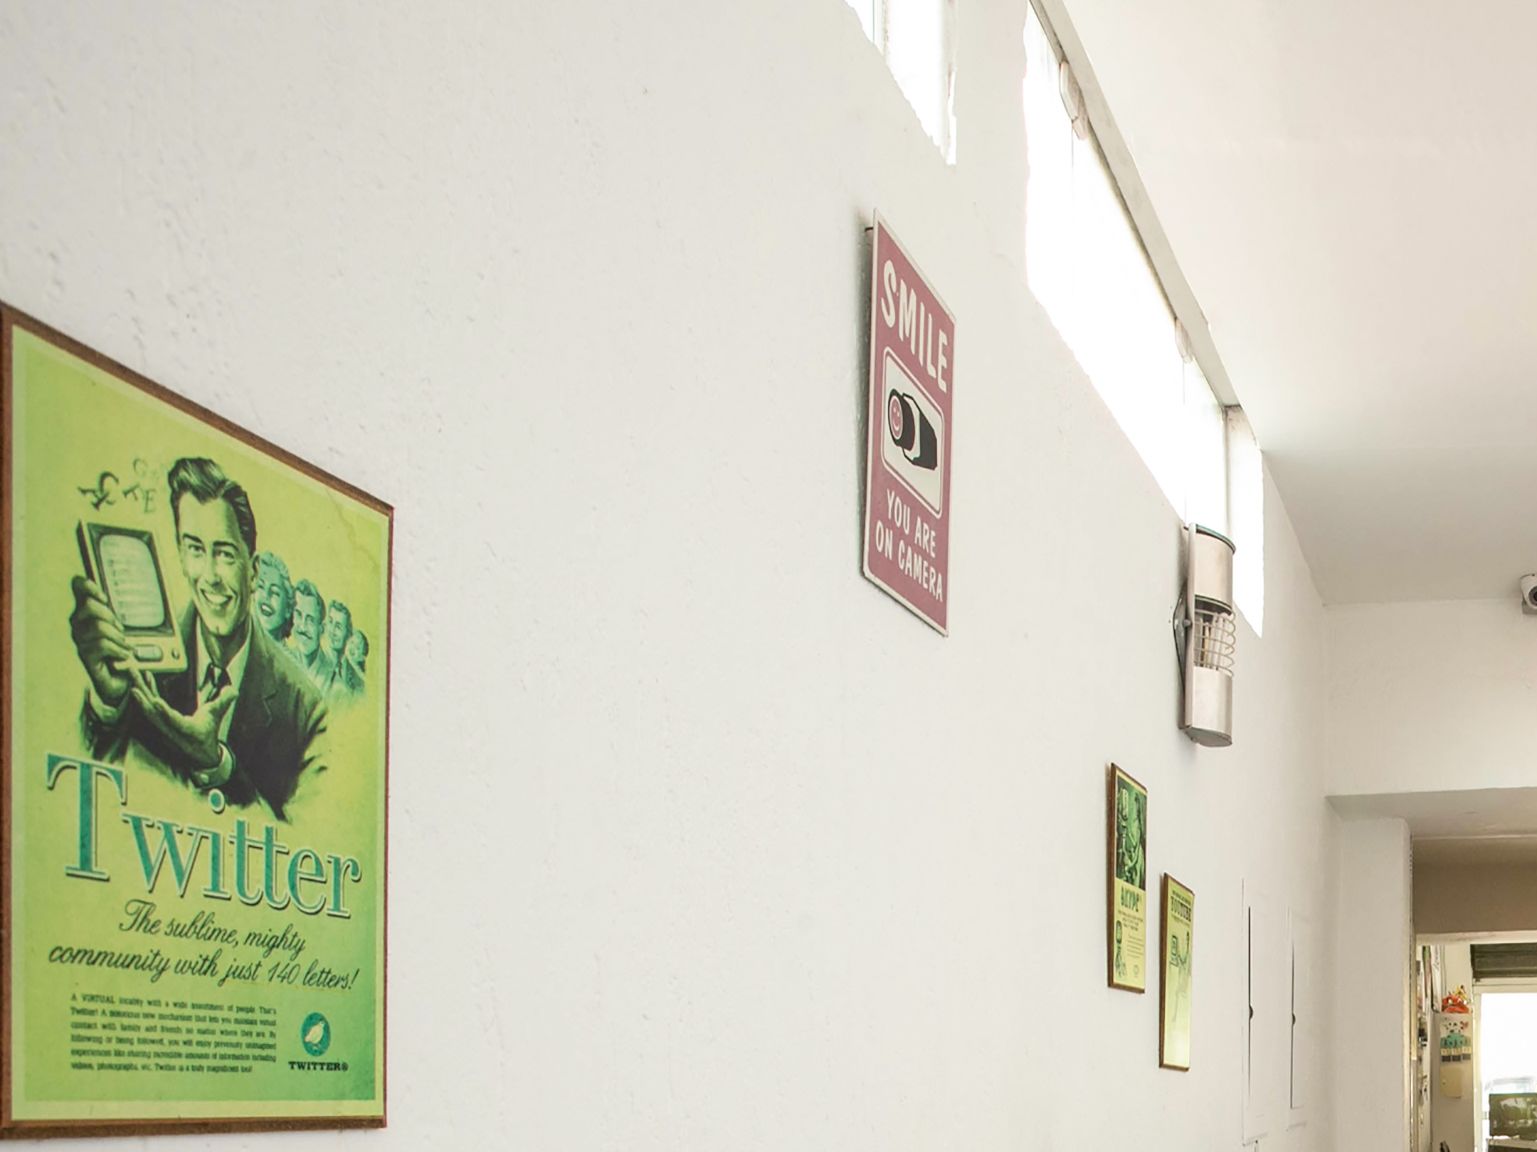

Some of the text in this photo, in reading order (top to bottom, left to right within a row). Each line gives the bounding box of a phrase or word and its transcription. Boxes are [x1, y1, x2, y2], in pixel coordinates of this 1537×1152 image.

[881, 259, 948, 394] SMILE
[876, 519, 943, 603] ON CAMERA
[887, 488, 936, 558] YOU ARE
[47, 753, 362, 919] Twitter
[48, 946, 360, 990] community with just 140 letters!
[119, 898, 306, 961] The sublime, mighty
